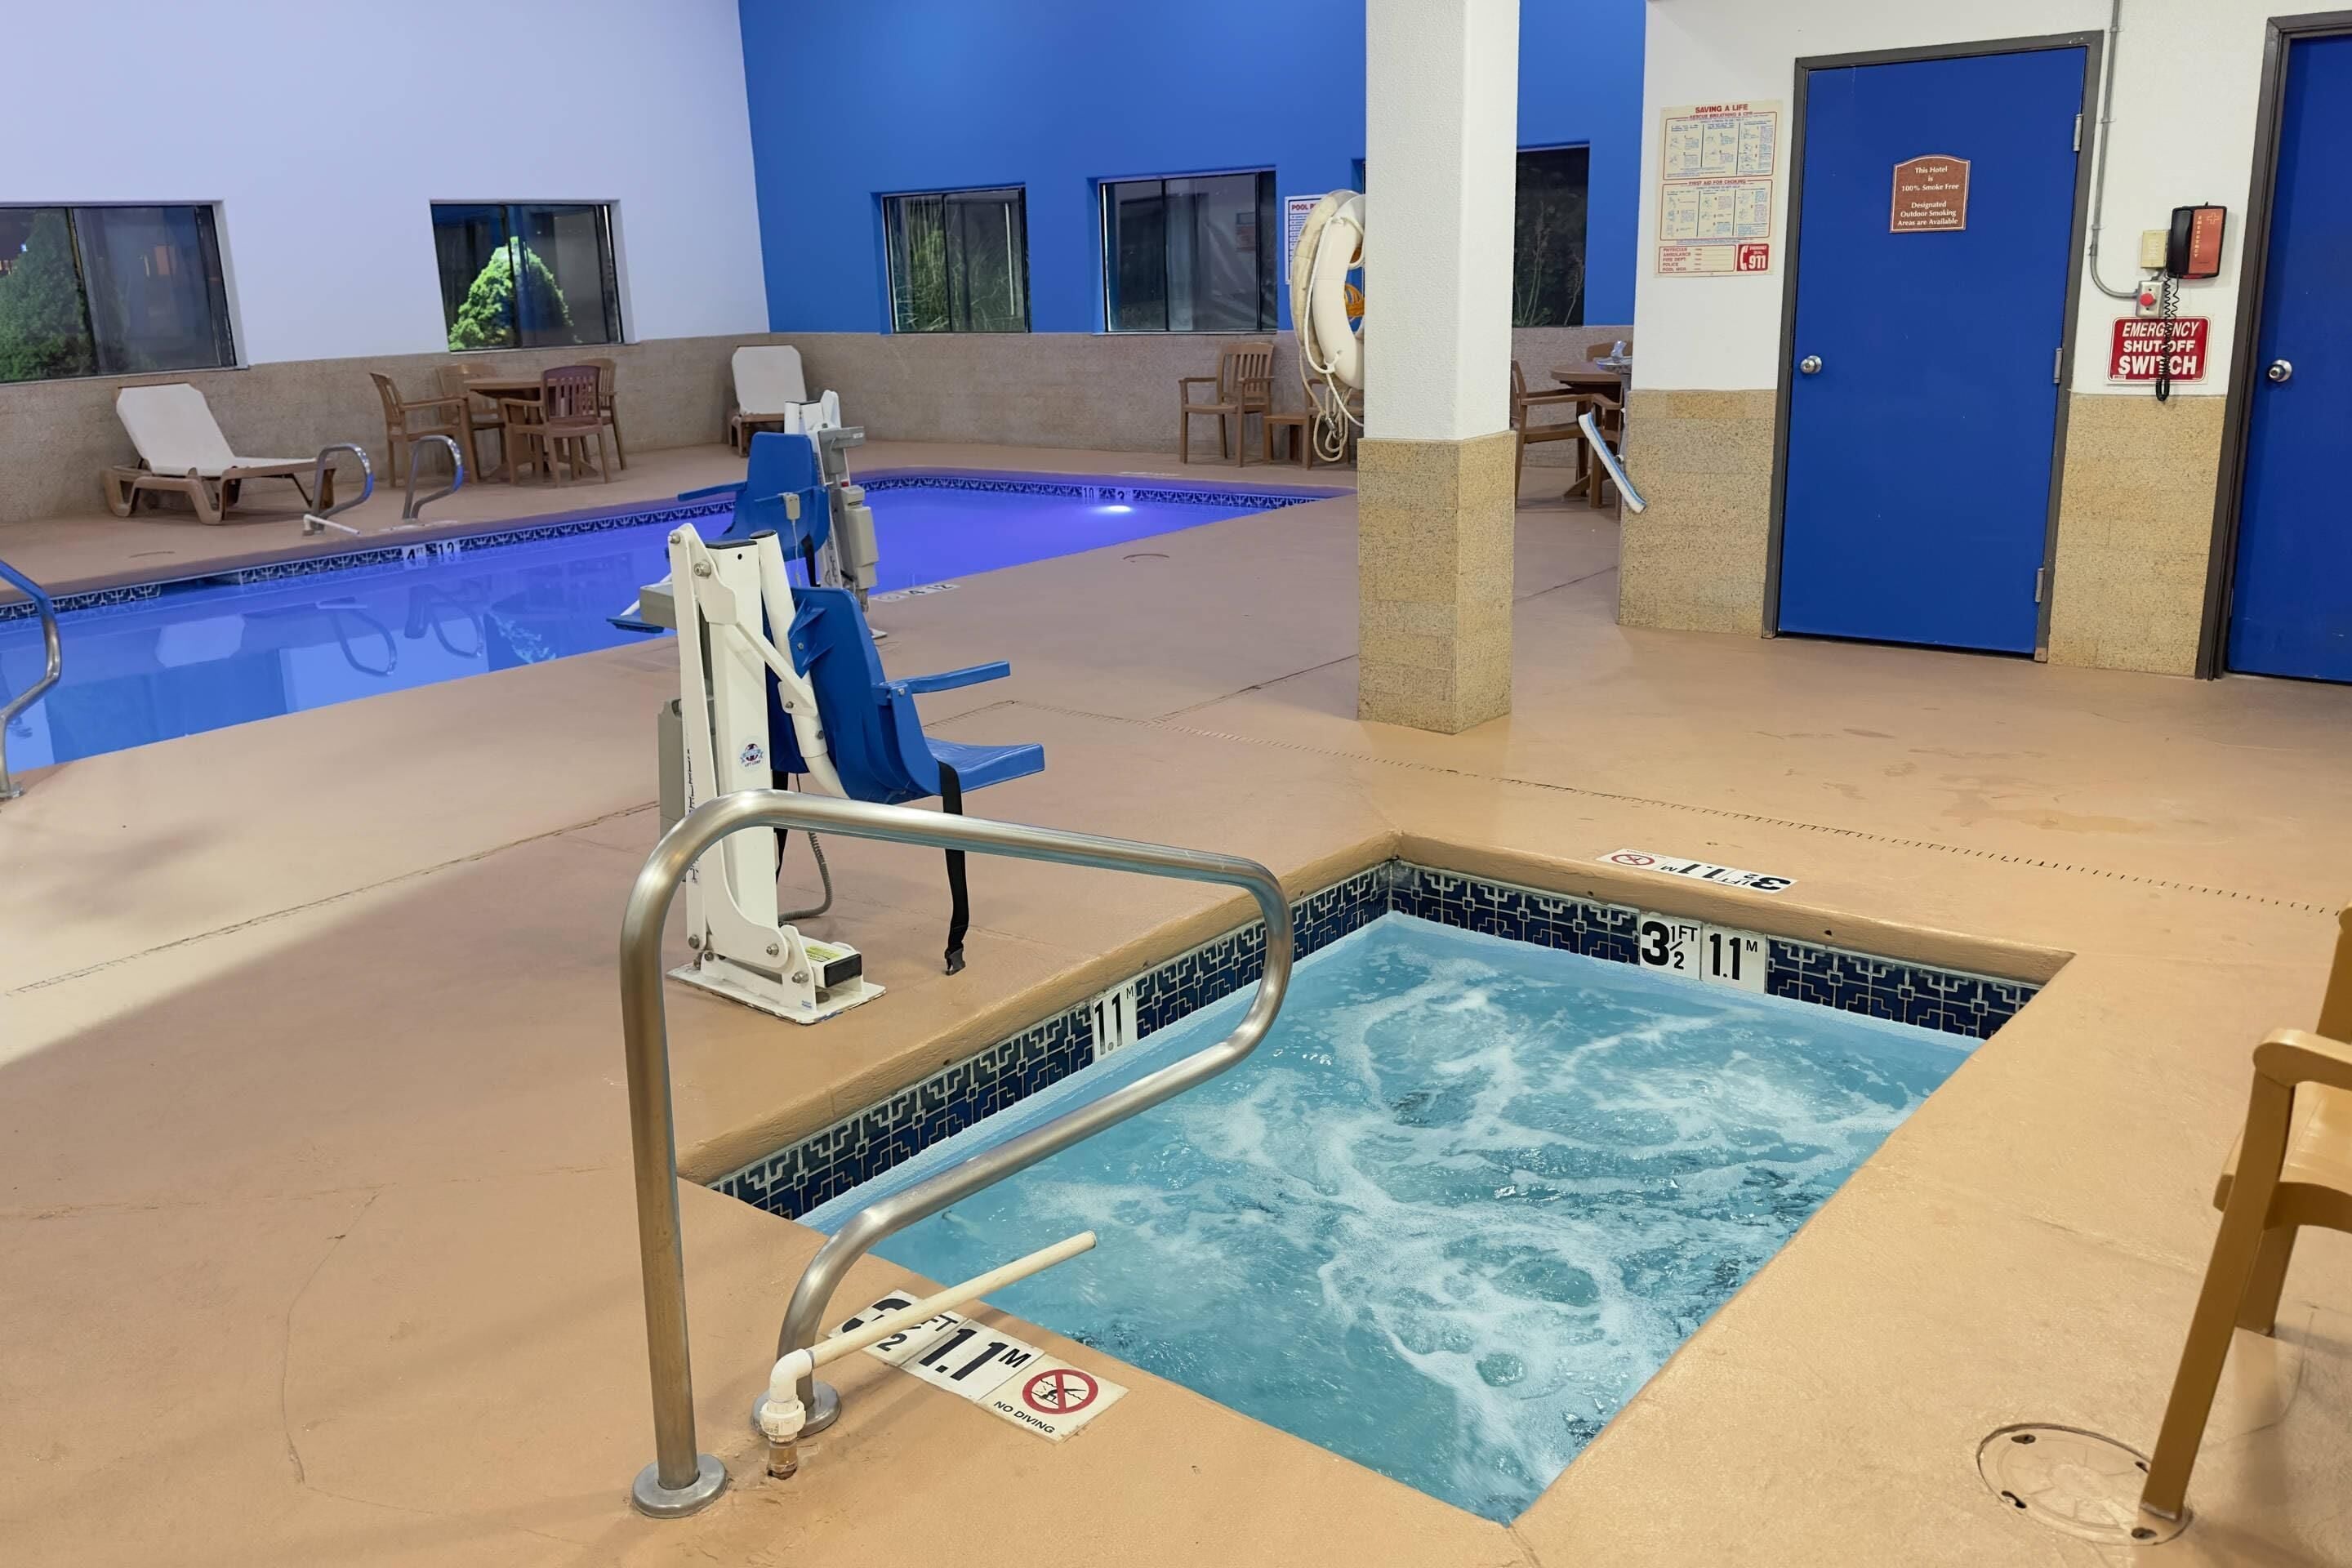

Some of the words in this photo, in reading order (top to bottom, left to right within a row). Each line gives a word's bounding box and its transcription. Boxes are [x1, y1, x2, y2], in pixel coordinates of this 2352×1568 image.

[1695, 105, 1722, 114] SAVING
[1912, 201, 1946, 209] Designated
[1929, 209, 1957, 217] Smoking
[1748, 255, 1766, 270] 911
[2123, 321, 2199, 337] EMERGNCY
[1641, 920, 1670, 966] 3
[1746, 940, 1758, 953] M
[1126, 985, 1134, 1000] M
[997, 1348, 1031, 1369] M
[993, 1401, 1014, 1413] NO
[1013, 1410, 1055, 1434] DIVING
